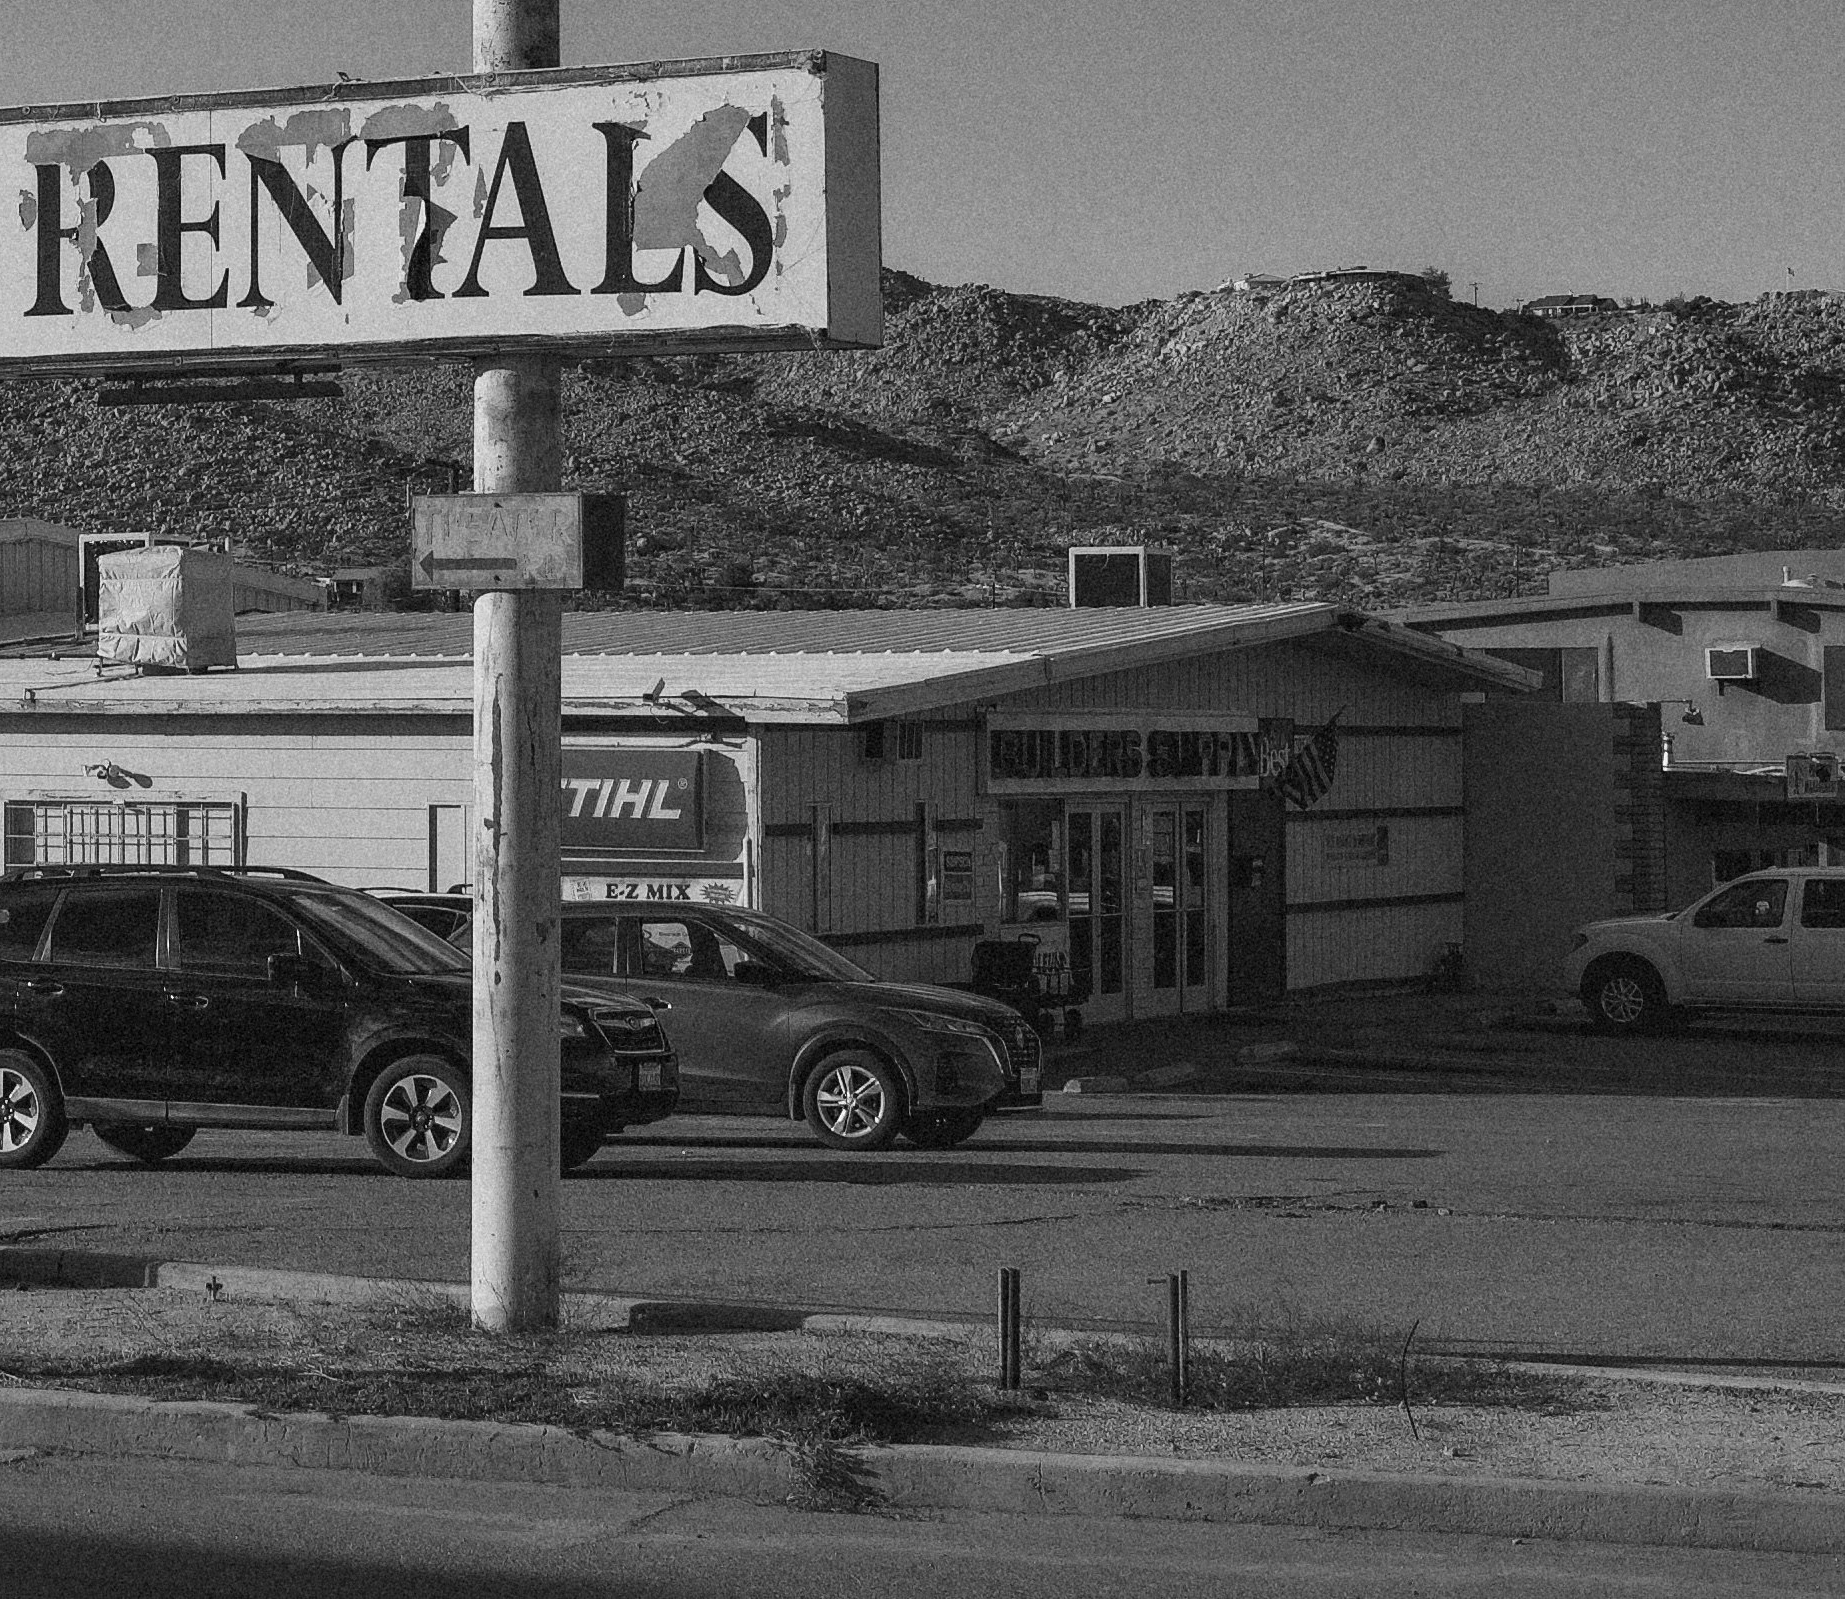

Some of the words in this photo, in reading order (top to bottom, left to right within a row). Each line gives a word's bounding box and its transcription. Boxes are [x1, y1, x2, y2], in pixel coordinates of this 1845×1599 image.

[22, 110, 776, 317] RENTALS
[560, 778, 683, 820] TIHL
[605, 883, 640, 900] E-Z
[646, 883, 692, 901] MIX
